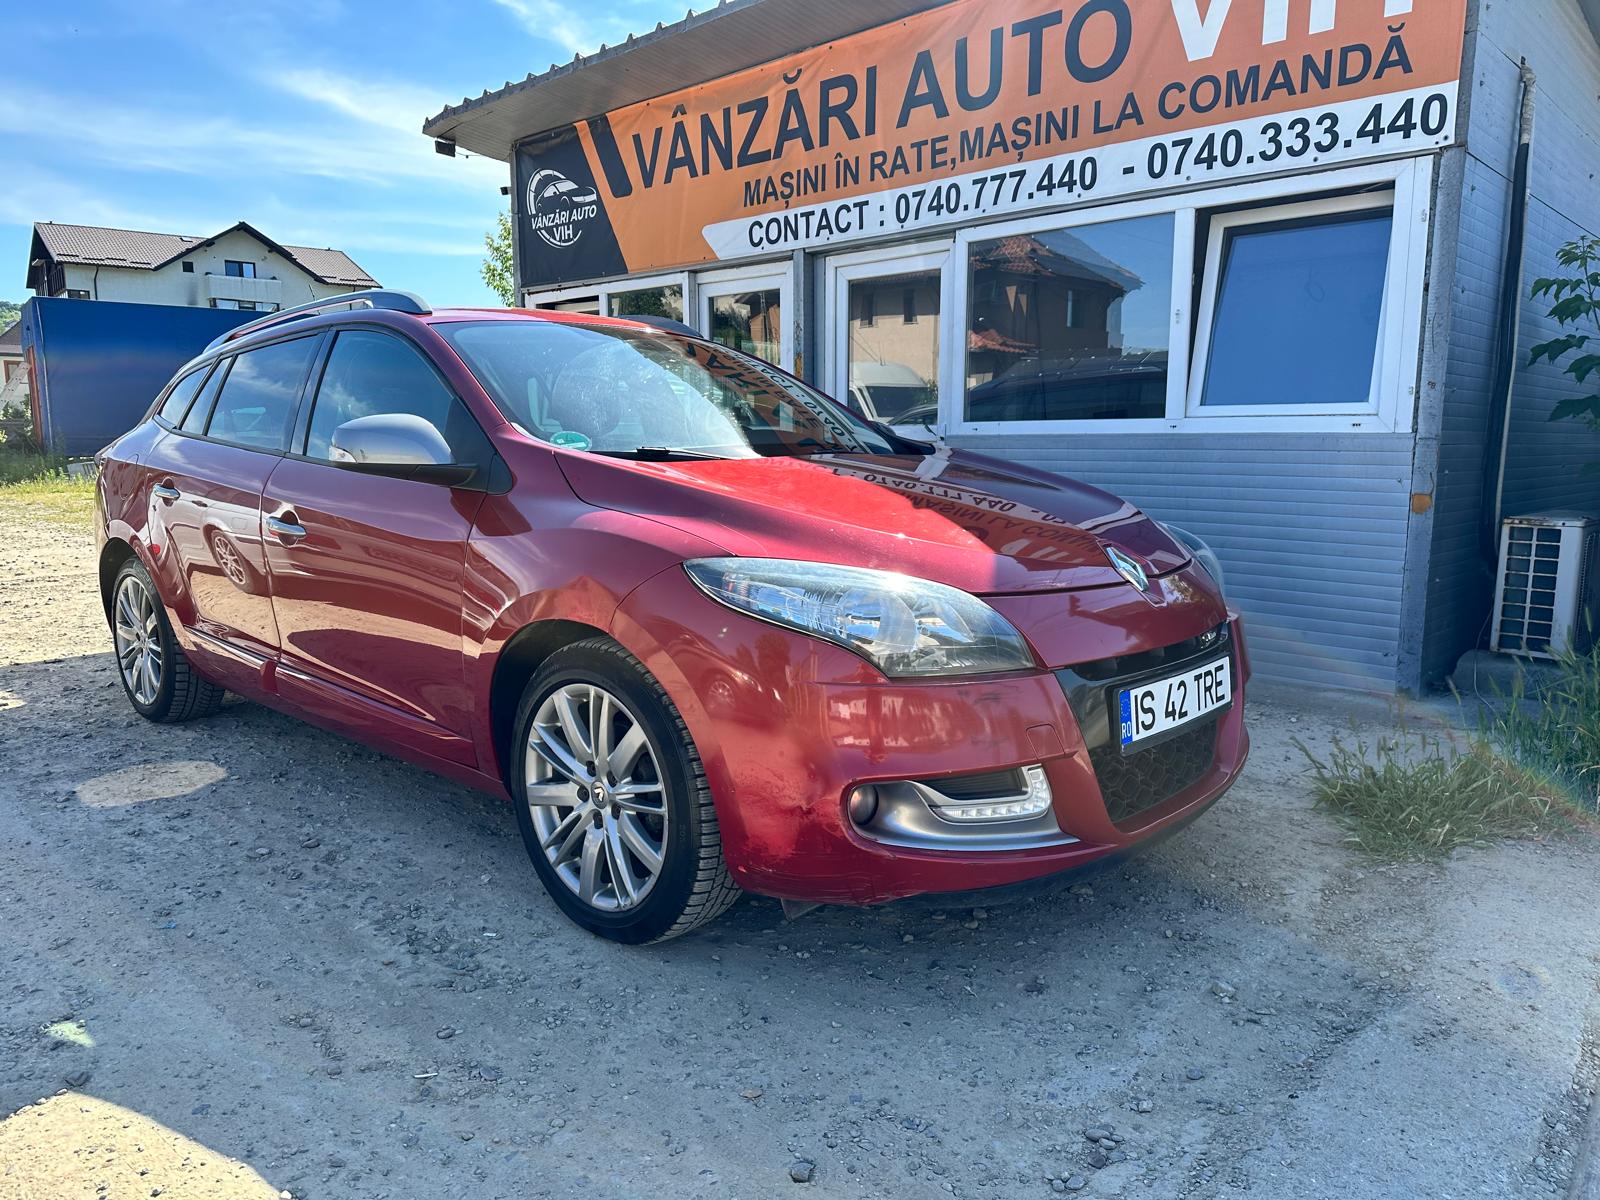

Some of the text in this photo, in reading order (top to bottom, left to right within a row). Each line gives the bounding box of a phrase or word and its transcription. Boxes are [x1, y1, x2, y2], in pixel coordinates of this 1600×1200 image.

[632, 65, 877, 188] VÂNZĂRI
[896, 0, 1132, 128] AUTO
[743, 162, 827, 208] MAȘINI
[835, 152, 861, 190] ÎN
[1093, 91, 1145, 134] LA
[1157, 22, 1414, 120] COMANDĂ
[748, 200, 870, 248] CONTACT
[894, 155, 1098, 225] 0740.777.440
[1146, 93, 1449, 180] 0740.333.440
[553, 224, 573, 241] VIH
[570, 204, 597, 222] AUTO
[1121, 721, 1132, 739] RO
[1133, 664, 1226, 735] IS 42 TRE
